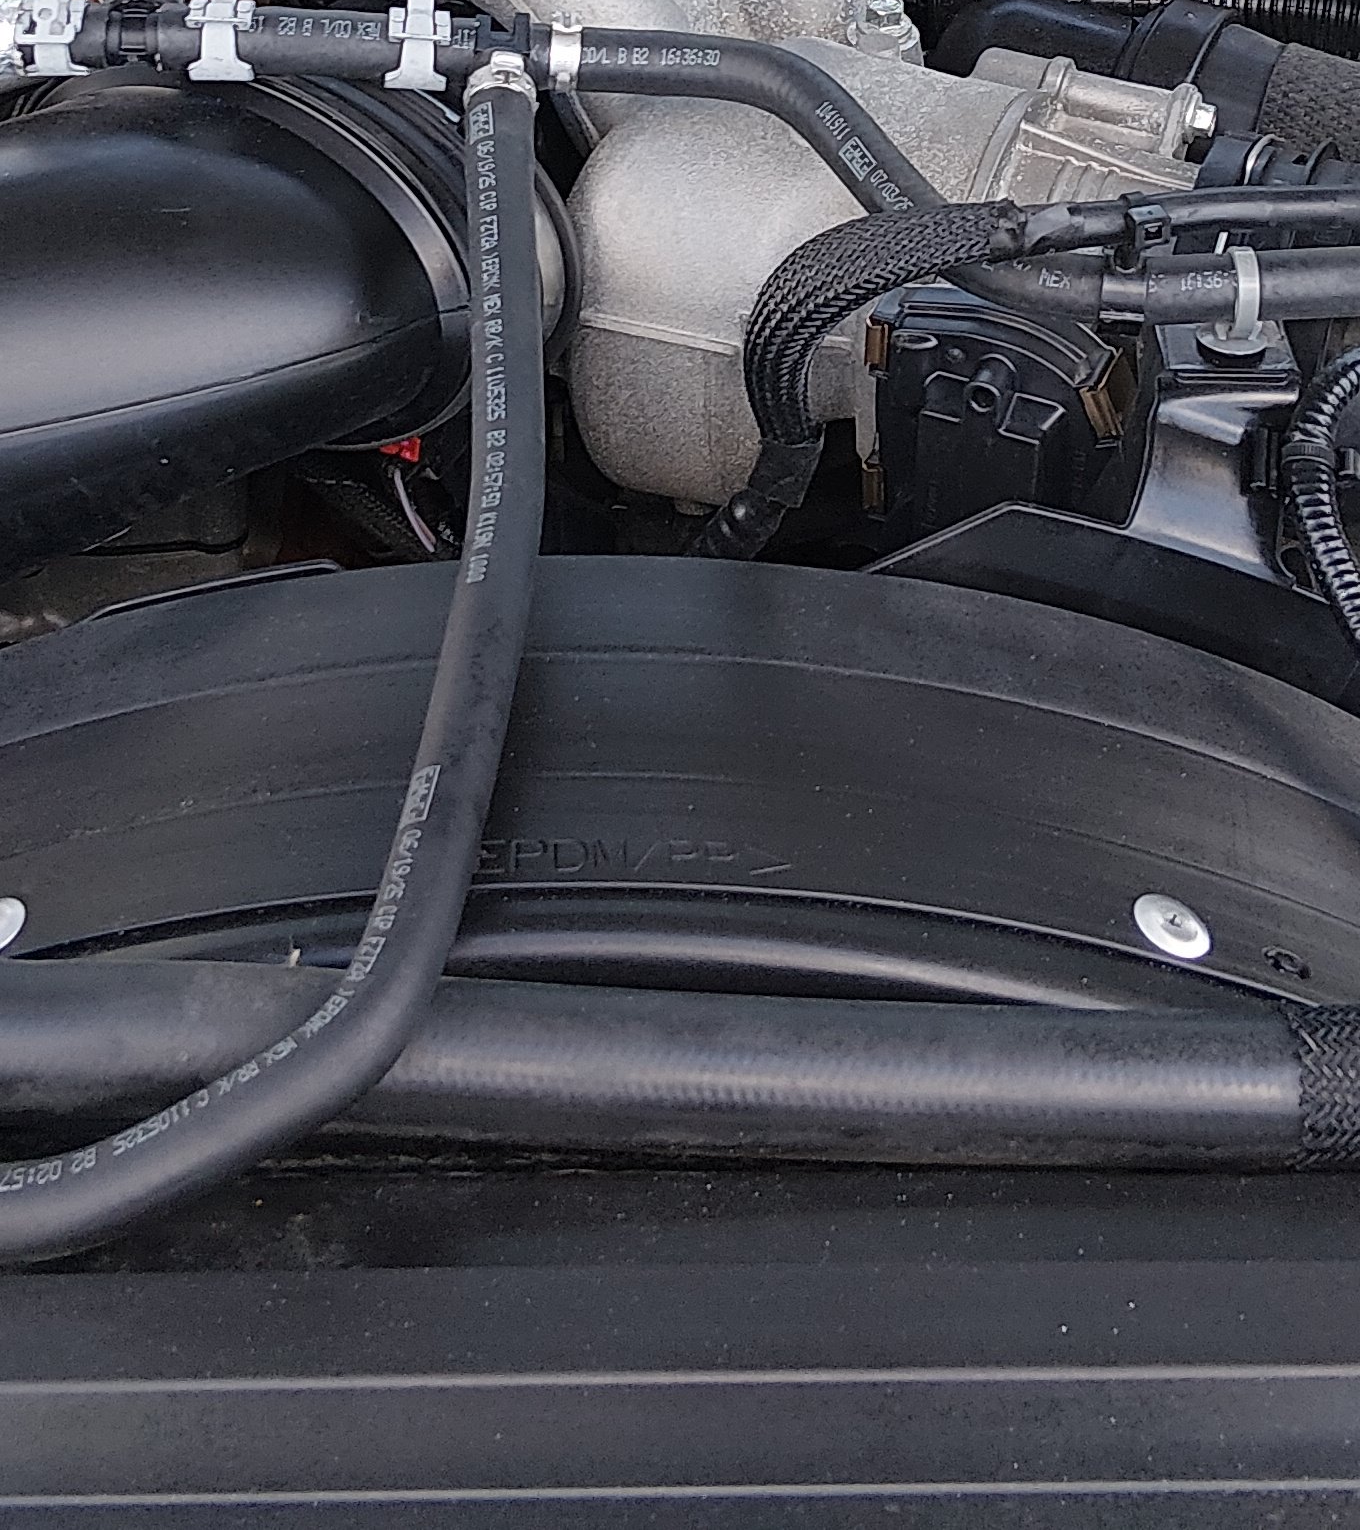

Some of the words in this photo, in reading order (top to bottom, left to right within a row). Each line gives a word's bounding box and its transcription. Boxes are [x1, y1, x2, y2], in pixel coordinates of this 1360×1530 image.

[617, 47, 626, 64] B
[478, 190, 497, 211] CIP
[484, 353, 505, 364] C
[195, 1088, 210, 1108] C
[70, 1146, 97, 1173] B2
